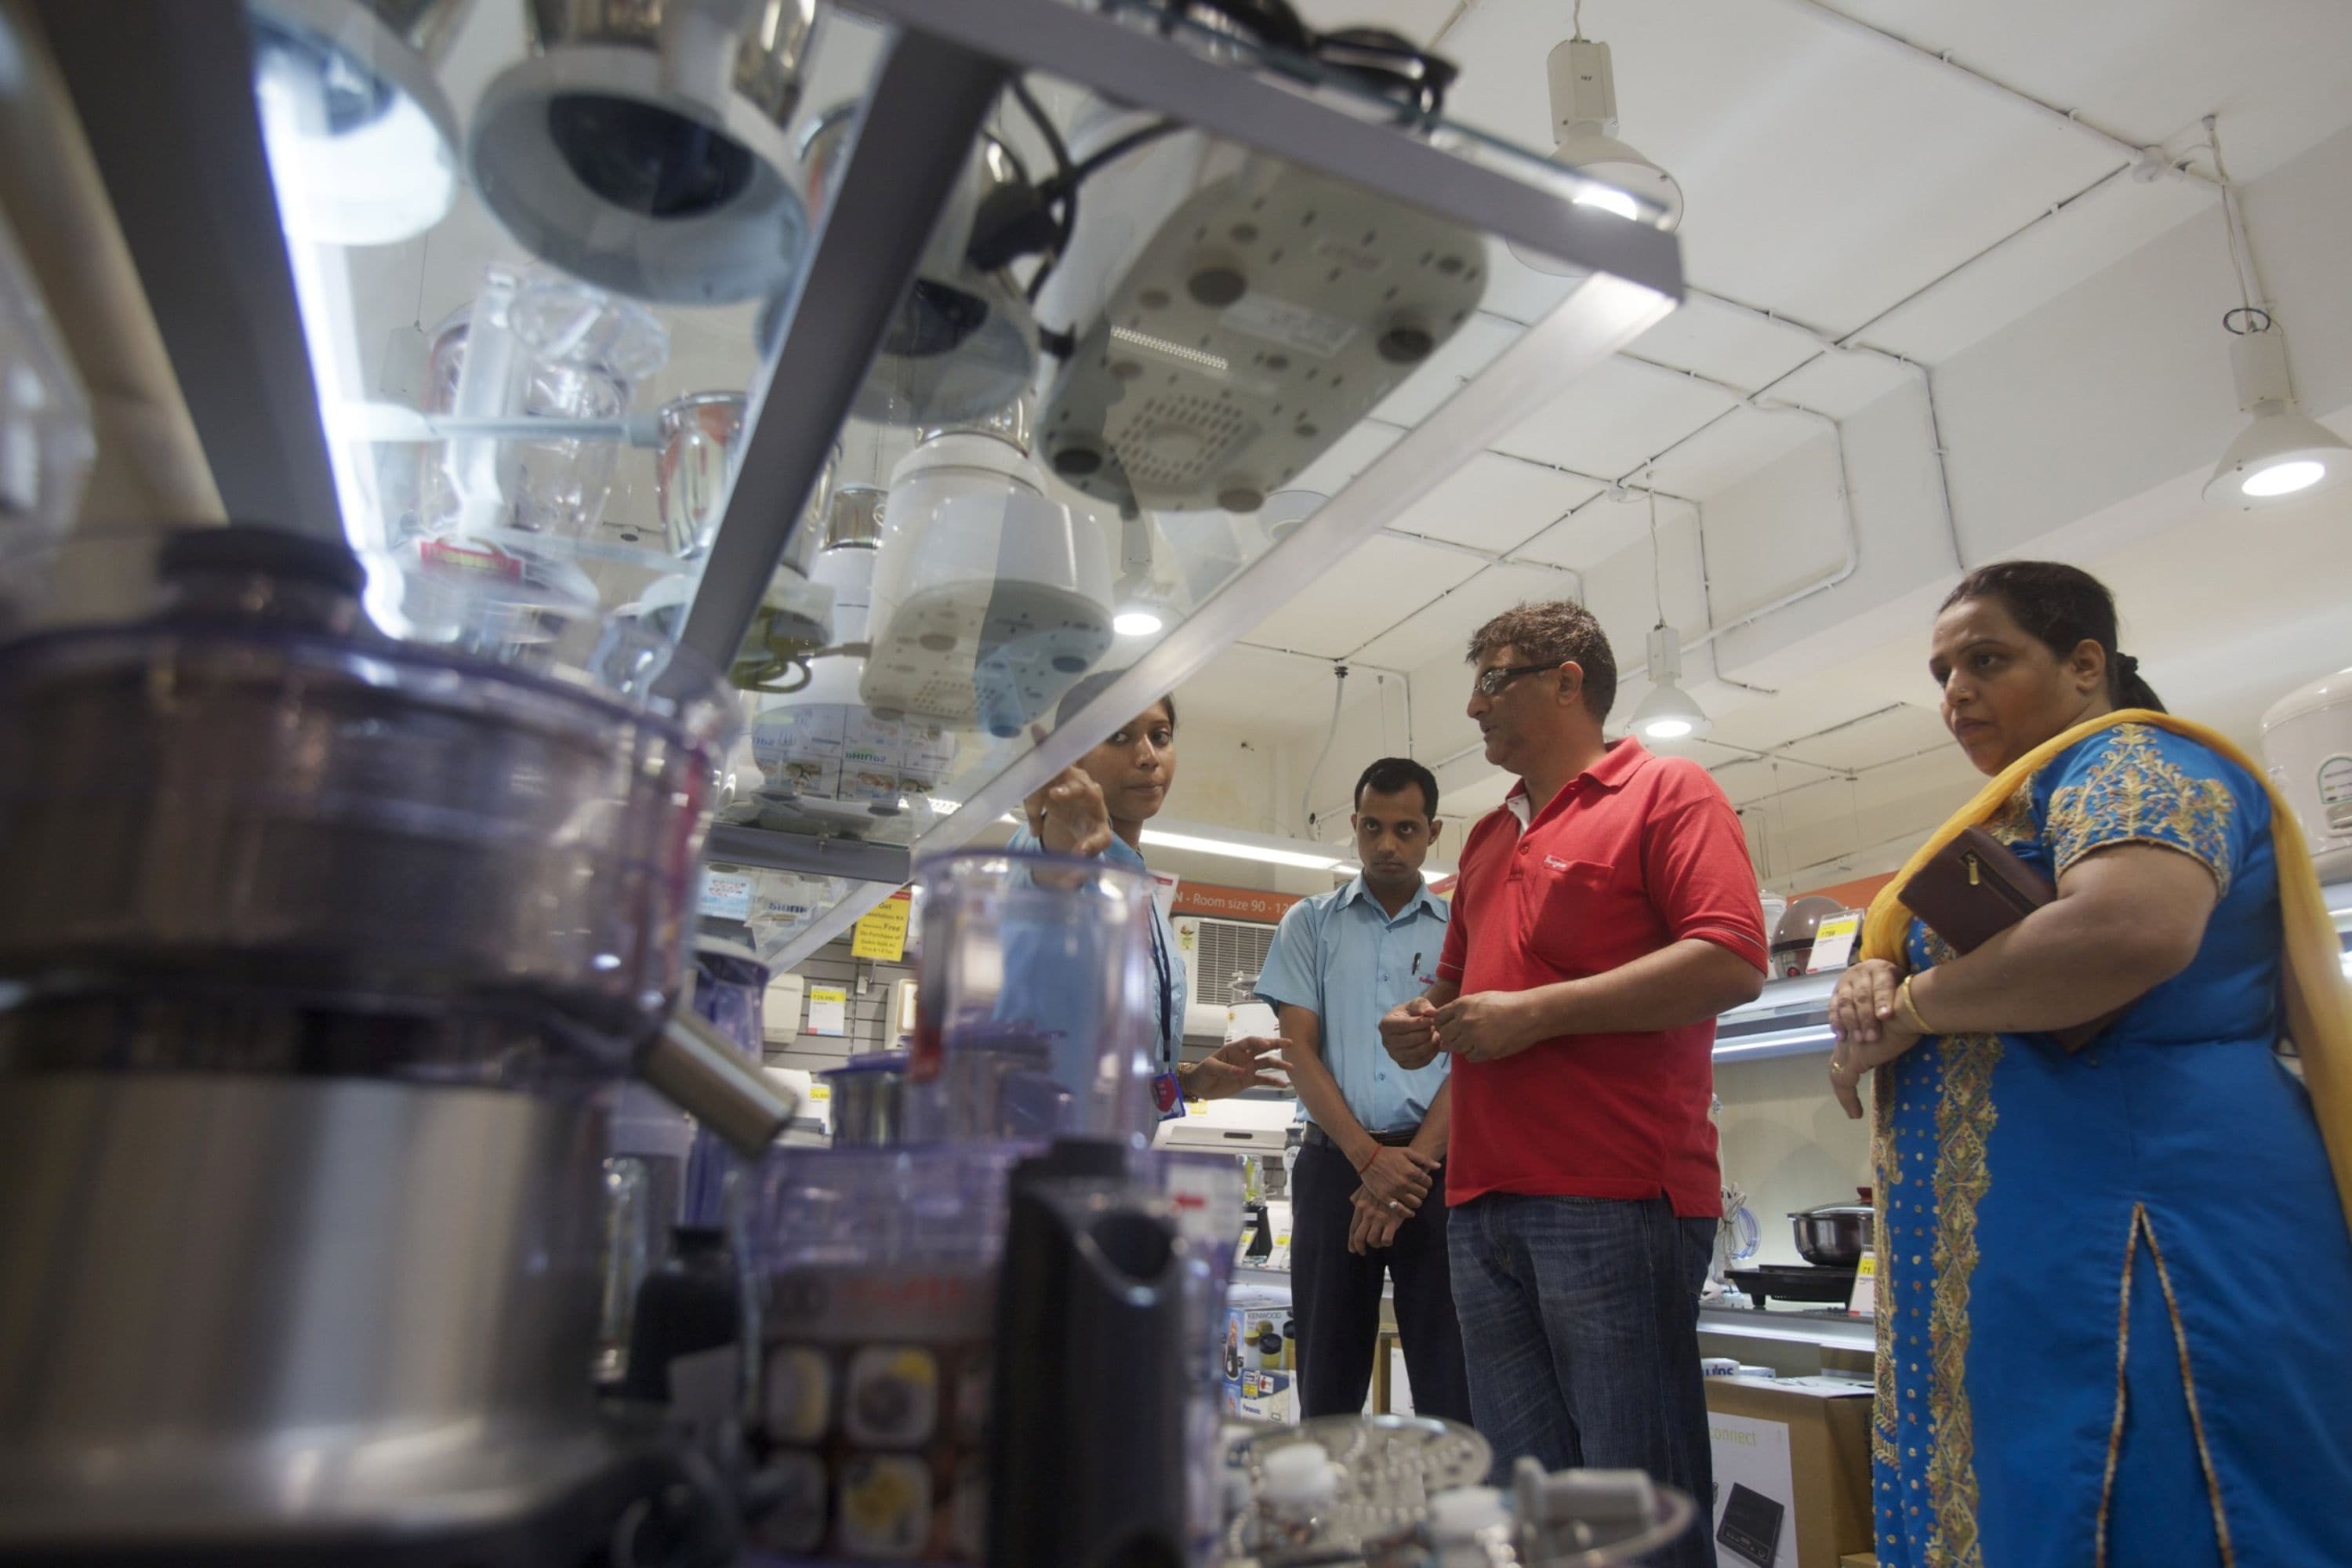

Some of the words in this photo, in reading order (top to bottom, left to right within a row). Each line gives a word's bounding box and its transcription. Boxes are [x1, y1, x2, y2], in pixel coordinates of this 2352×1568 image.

[1193, 893, 1225, 908] Room
[1228, 898, 1249, 910] size
[1251, 900, 1265, 913] 90
[1276, 902, 1290, 916] 12
[884, 923, 901, 931] Free
